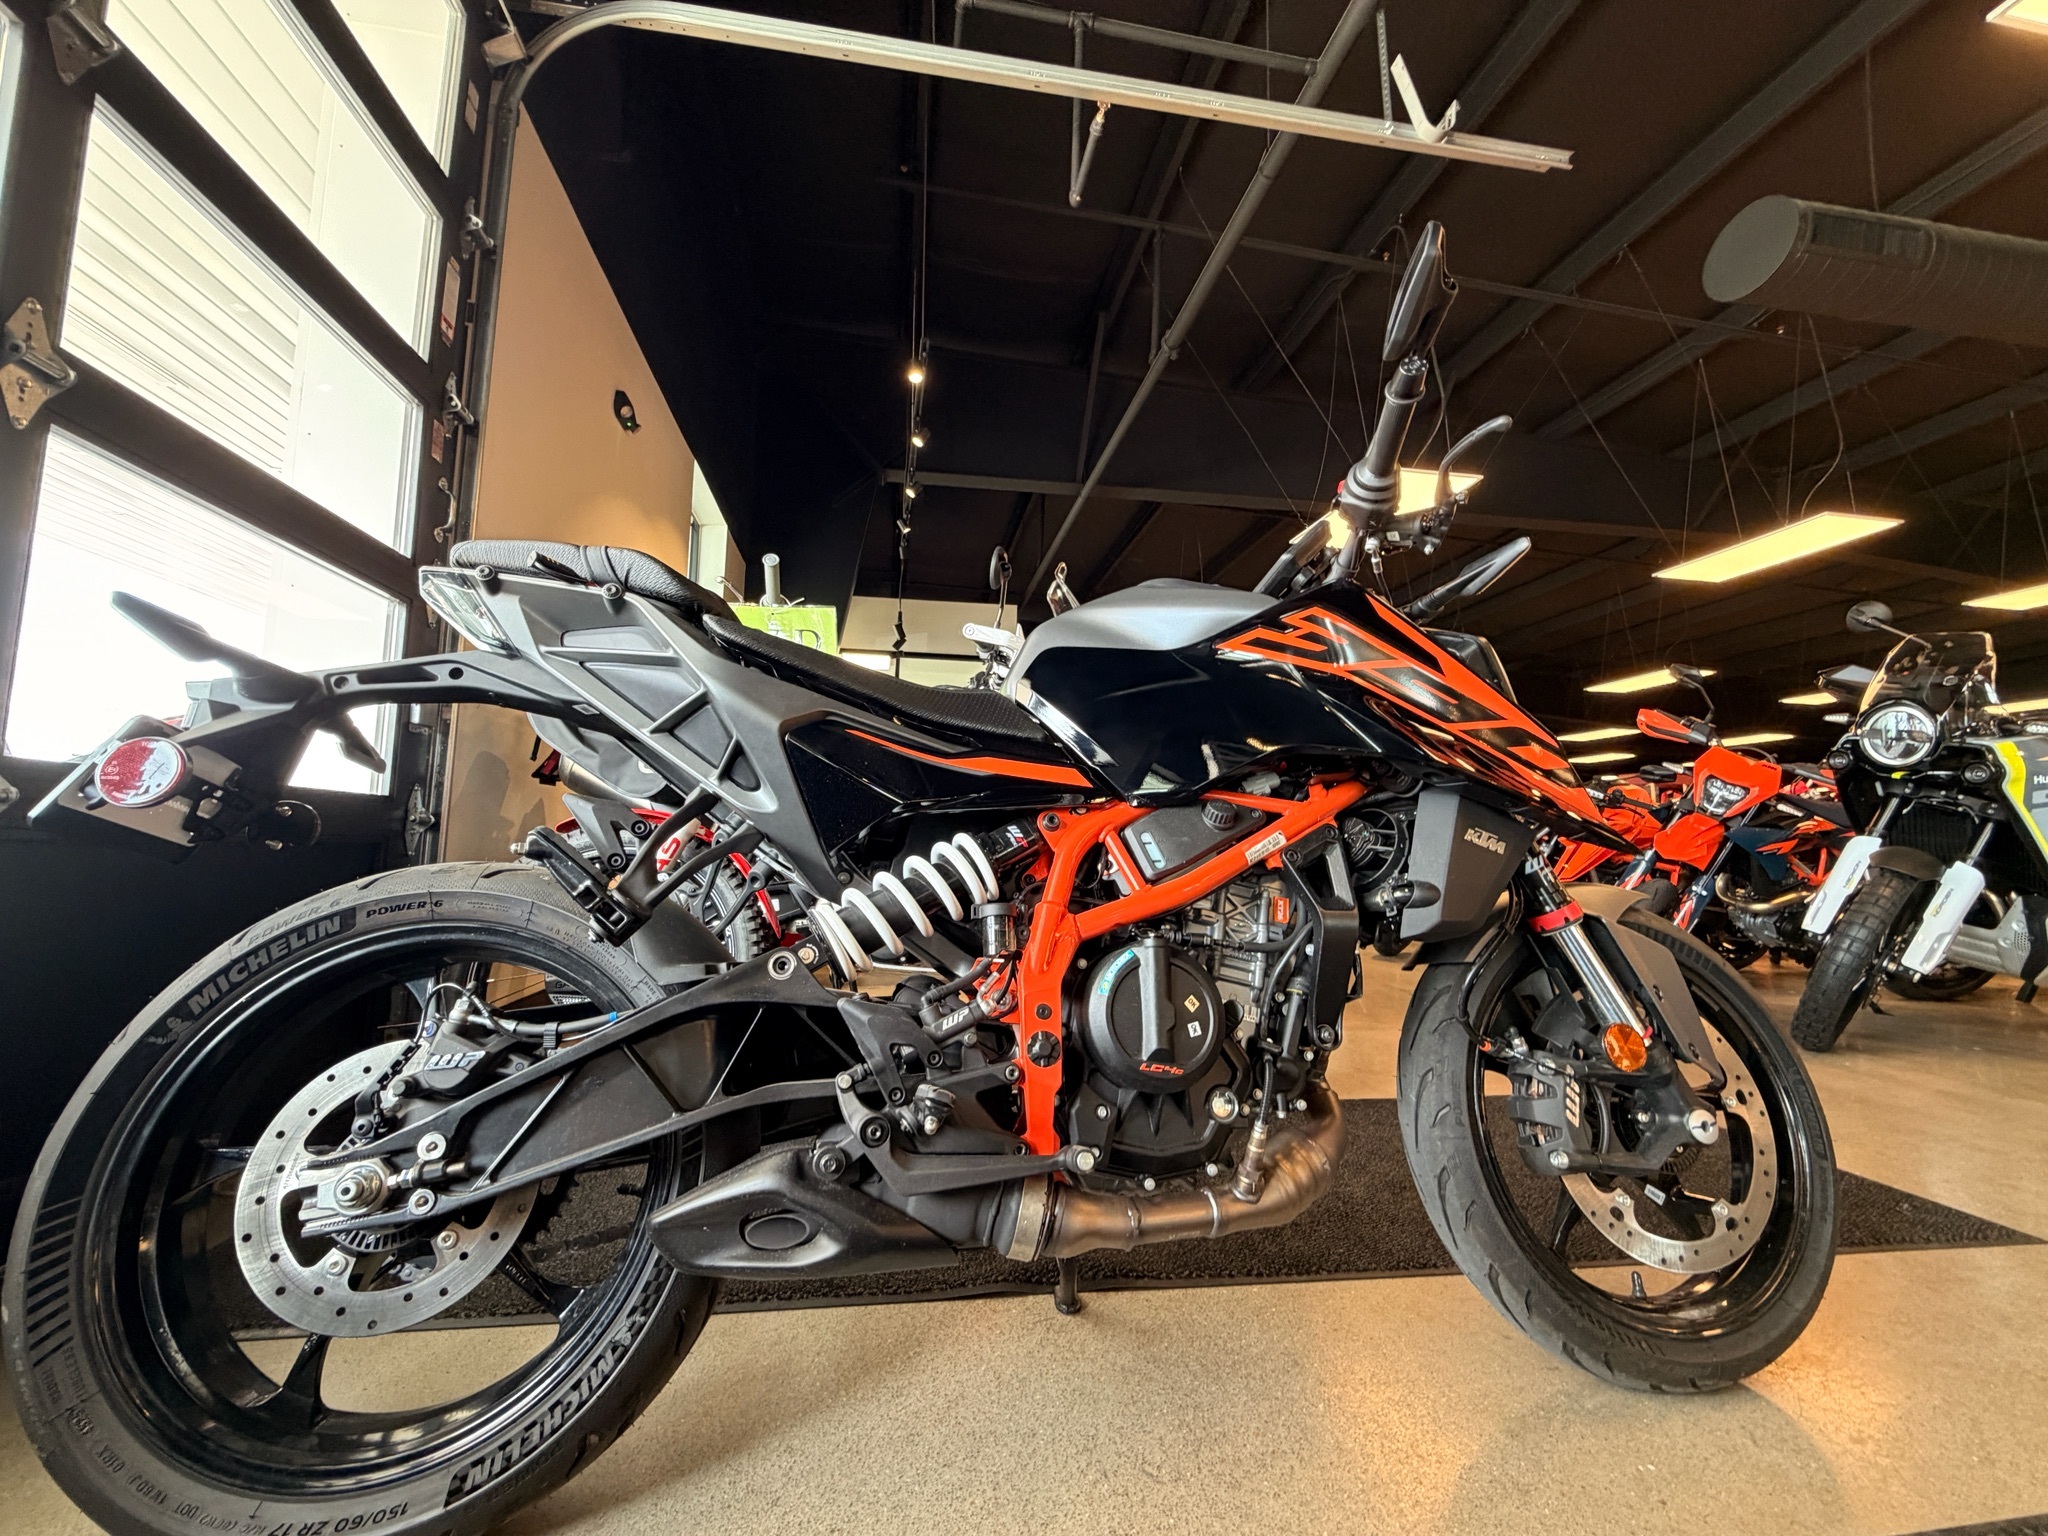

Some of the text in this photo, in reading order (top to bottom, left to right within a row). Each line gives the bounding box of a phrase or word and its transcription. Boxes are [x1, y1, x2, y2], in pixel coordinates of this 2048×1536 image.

[1464, 827, 1507, 855] KTM
[366, 900, 444, 918] POWER 6
[187, 915, 341, 1016] MICHELIN
[1187, 998, 1197, 1009] OK
[942, 1007, 970, 1031] WP
[1190, 1023, 1199, 1036] OK
[424, 1050, 486, 1072] WP
[463, 1350, 615, 1492] MICHELIN
[175, 1499, 200, 1520] DOT
[334, 1501, 409, 1533] 150/60
[267, 1521, 295, 1536] 17
[297, 1519, 330, 1536] ZR
